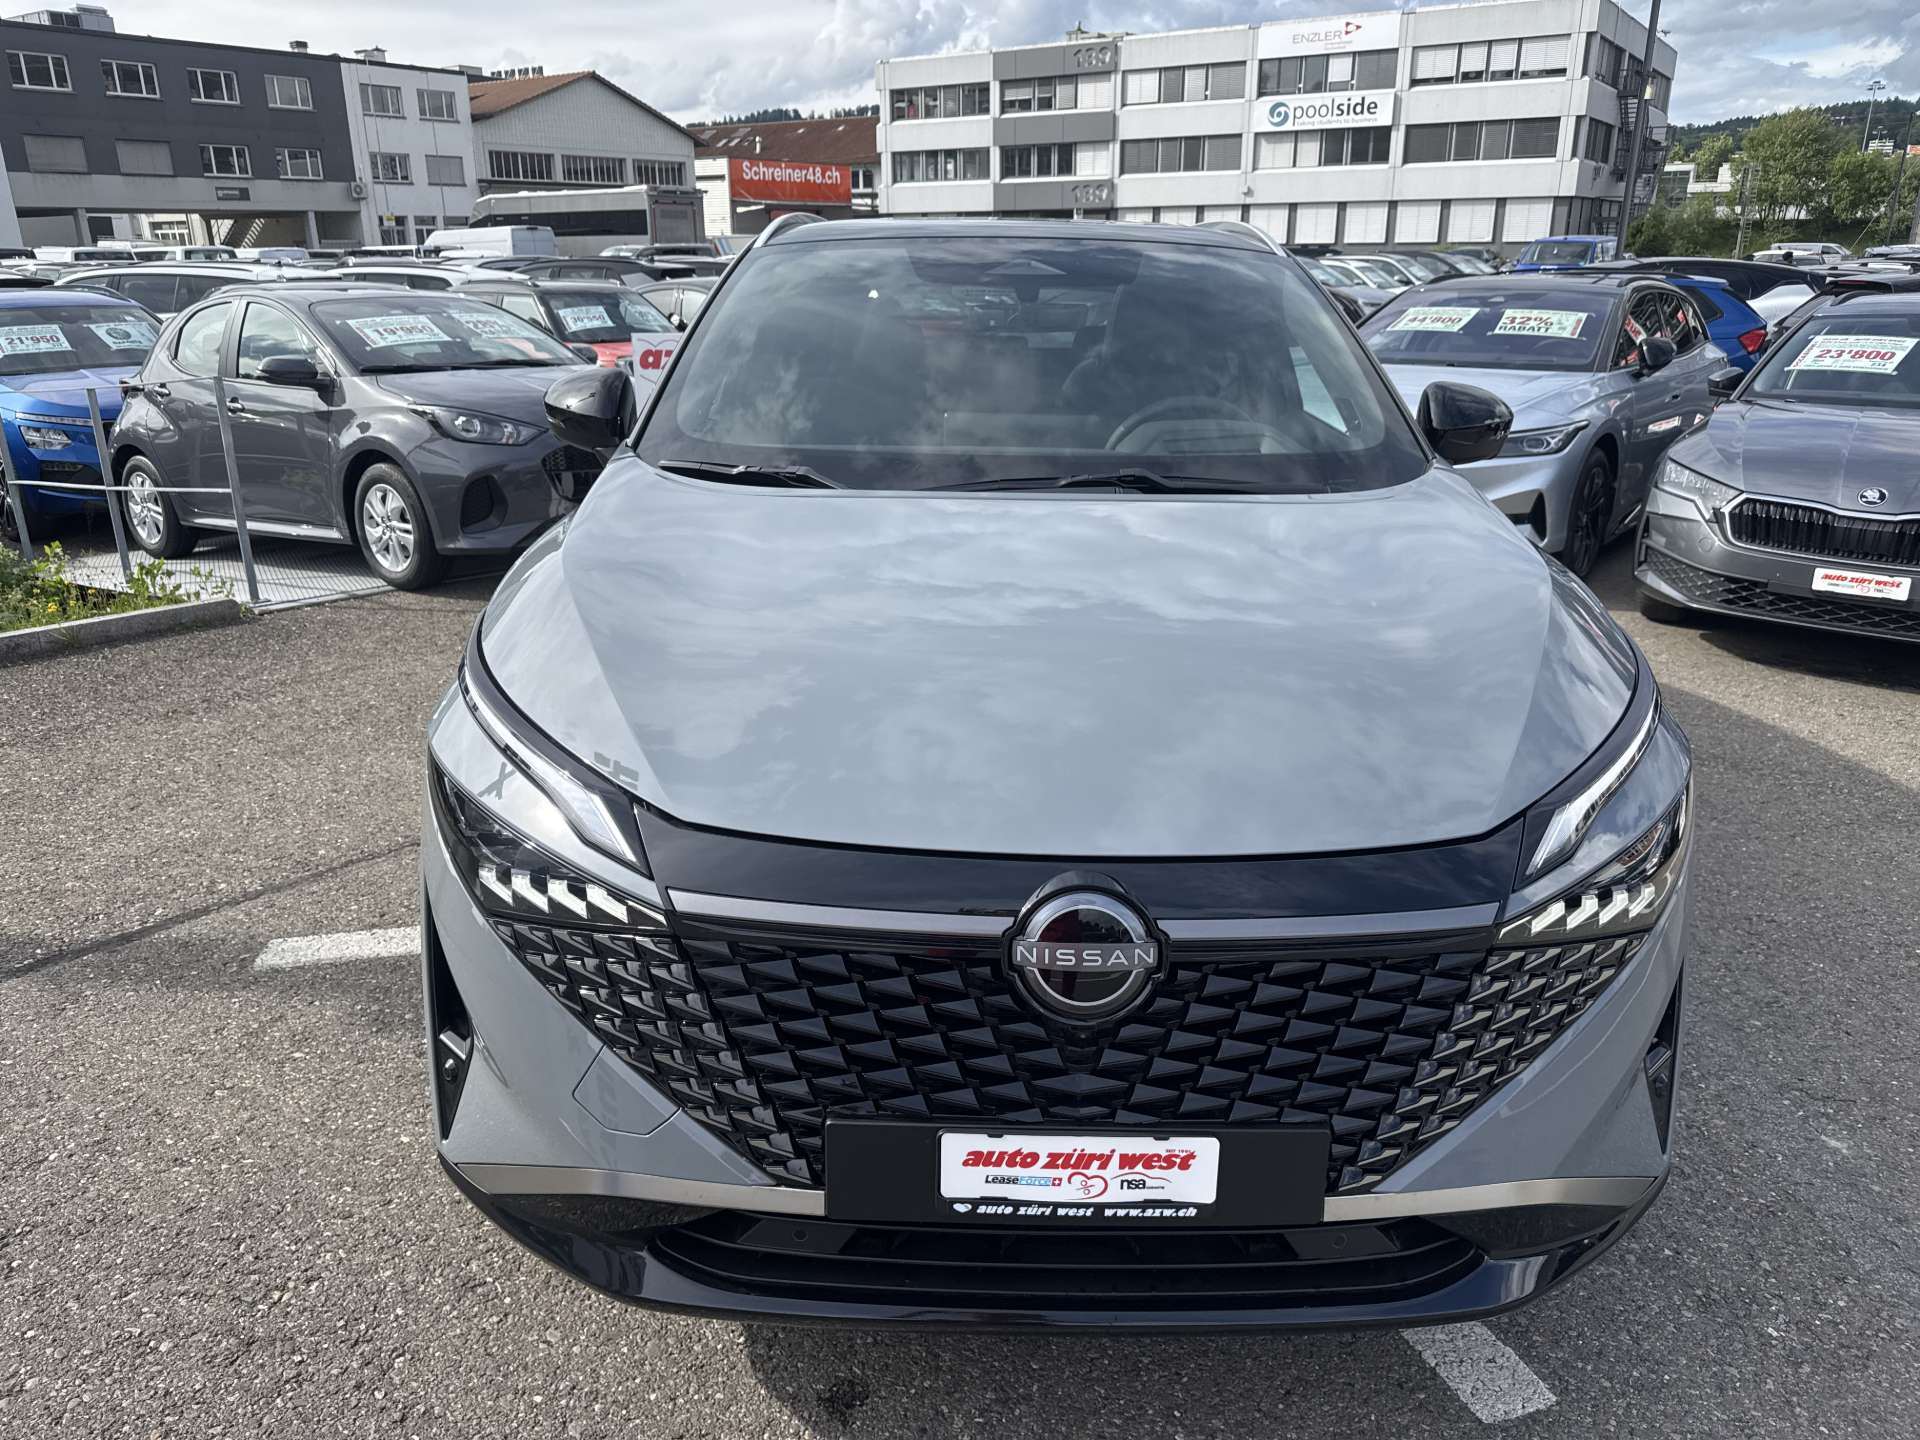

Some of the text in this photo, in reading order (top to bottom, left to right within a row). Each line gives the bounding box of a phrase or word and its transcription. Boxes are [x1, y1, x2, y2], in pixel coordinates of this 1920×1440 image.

[1292, 29, 1342, 44] ENZLER
[1292, 97, 1378, 126] poolside
[742, 160, 841, 185] Schreiner48.ch
[1501, 315, 1554, 327] 32%
[1498, 325, 1551, 334] RABATT
[5, 334, 61, 346] 21'950
[1814, 348, 1897, 361] 23'800
[1821, 573, 1848, 582] auto
[1875, 578, 1903, 588] west
[1016, 945, 1154, 967] NISSAN
[962, 1147, 1197, 1171] auto züri west
[1120, 1176, 1146, 1190] nsa
[977, 1204, 1198, 1217] auto züri west www.azw.ch
